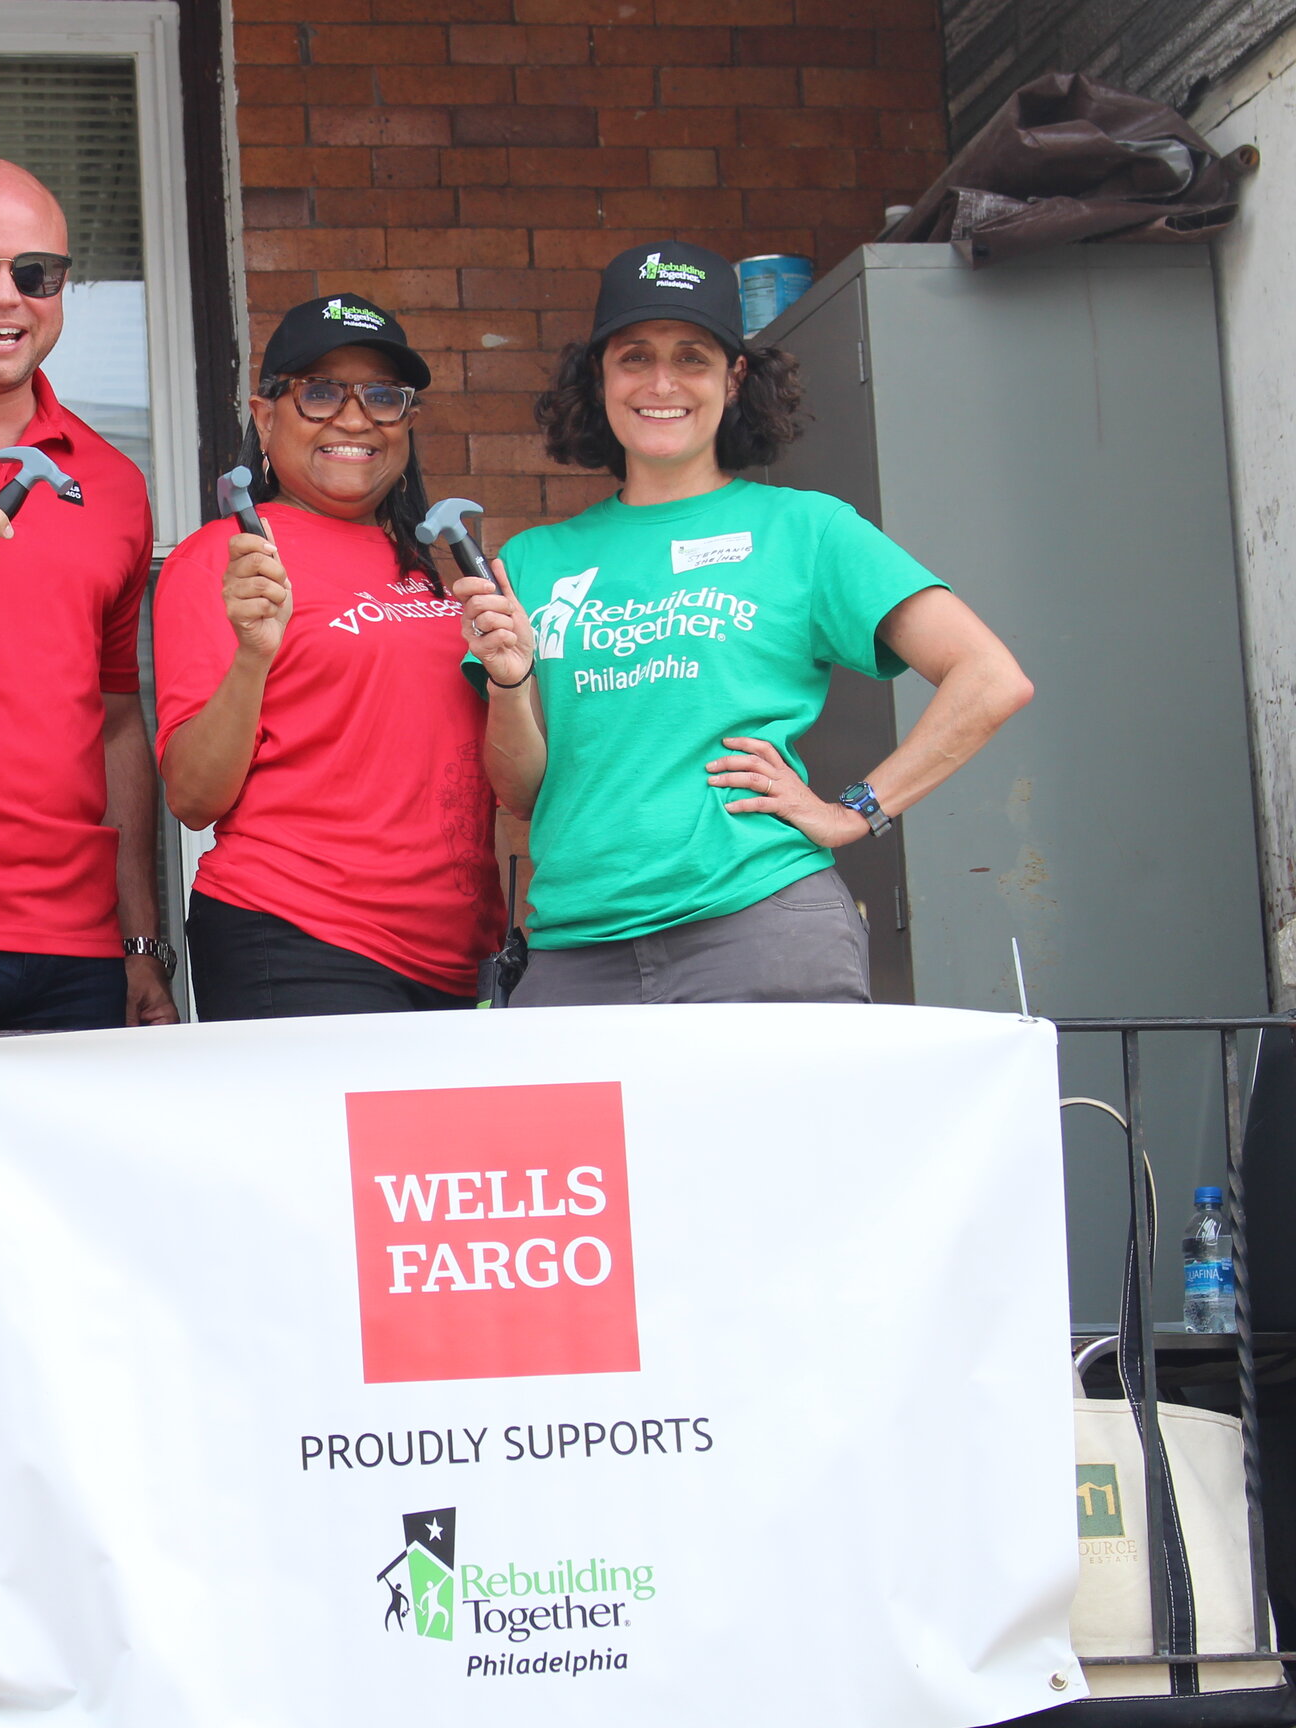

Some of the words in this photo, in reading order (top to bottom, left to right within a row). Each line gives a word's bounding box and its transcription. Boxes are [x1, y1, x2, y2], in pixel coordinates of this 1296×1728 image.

[658, 262, 706, 280] Rebuilding
[688, 545, 752, 562] STEPHANIE
[386, 577, 429, 596] Wells
[576, 587, 759, 631] Rebuilding
[574, 654, 699, 694] Philadelphia
[374, 1165, 607, 1223] WELLS
[386, 1236, 612, 1294] FARGO
[1186, 1268, 1221, 1281] UAFINA
[301, 1427, 488, 1471] PROUDLY
[504, 1417, 714, 1461] SUPPORTS
[1078, 1540, 1137, 1556] OURCE
[1089, 1554, 1138, 1565] ESTATE
[461, 1558, 656, 1601] Rebuilding
[467, 1647, 628, 1678] Philadelphia
